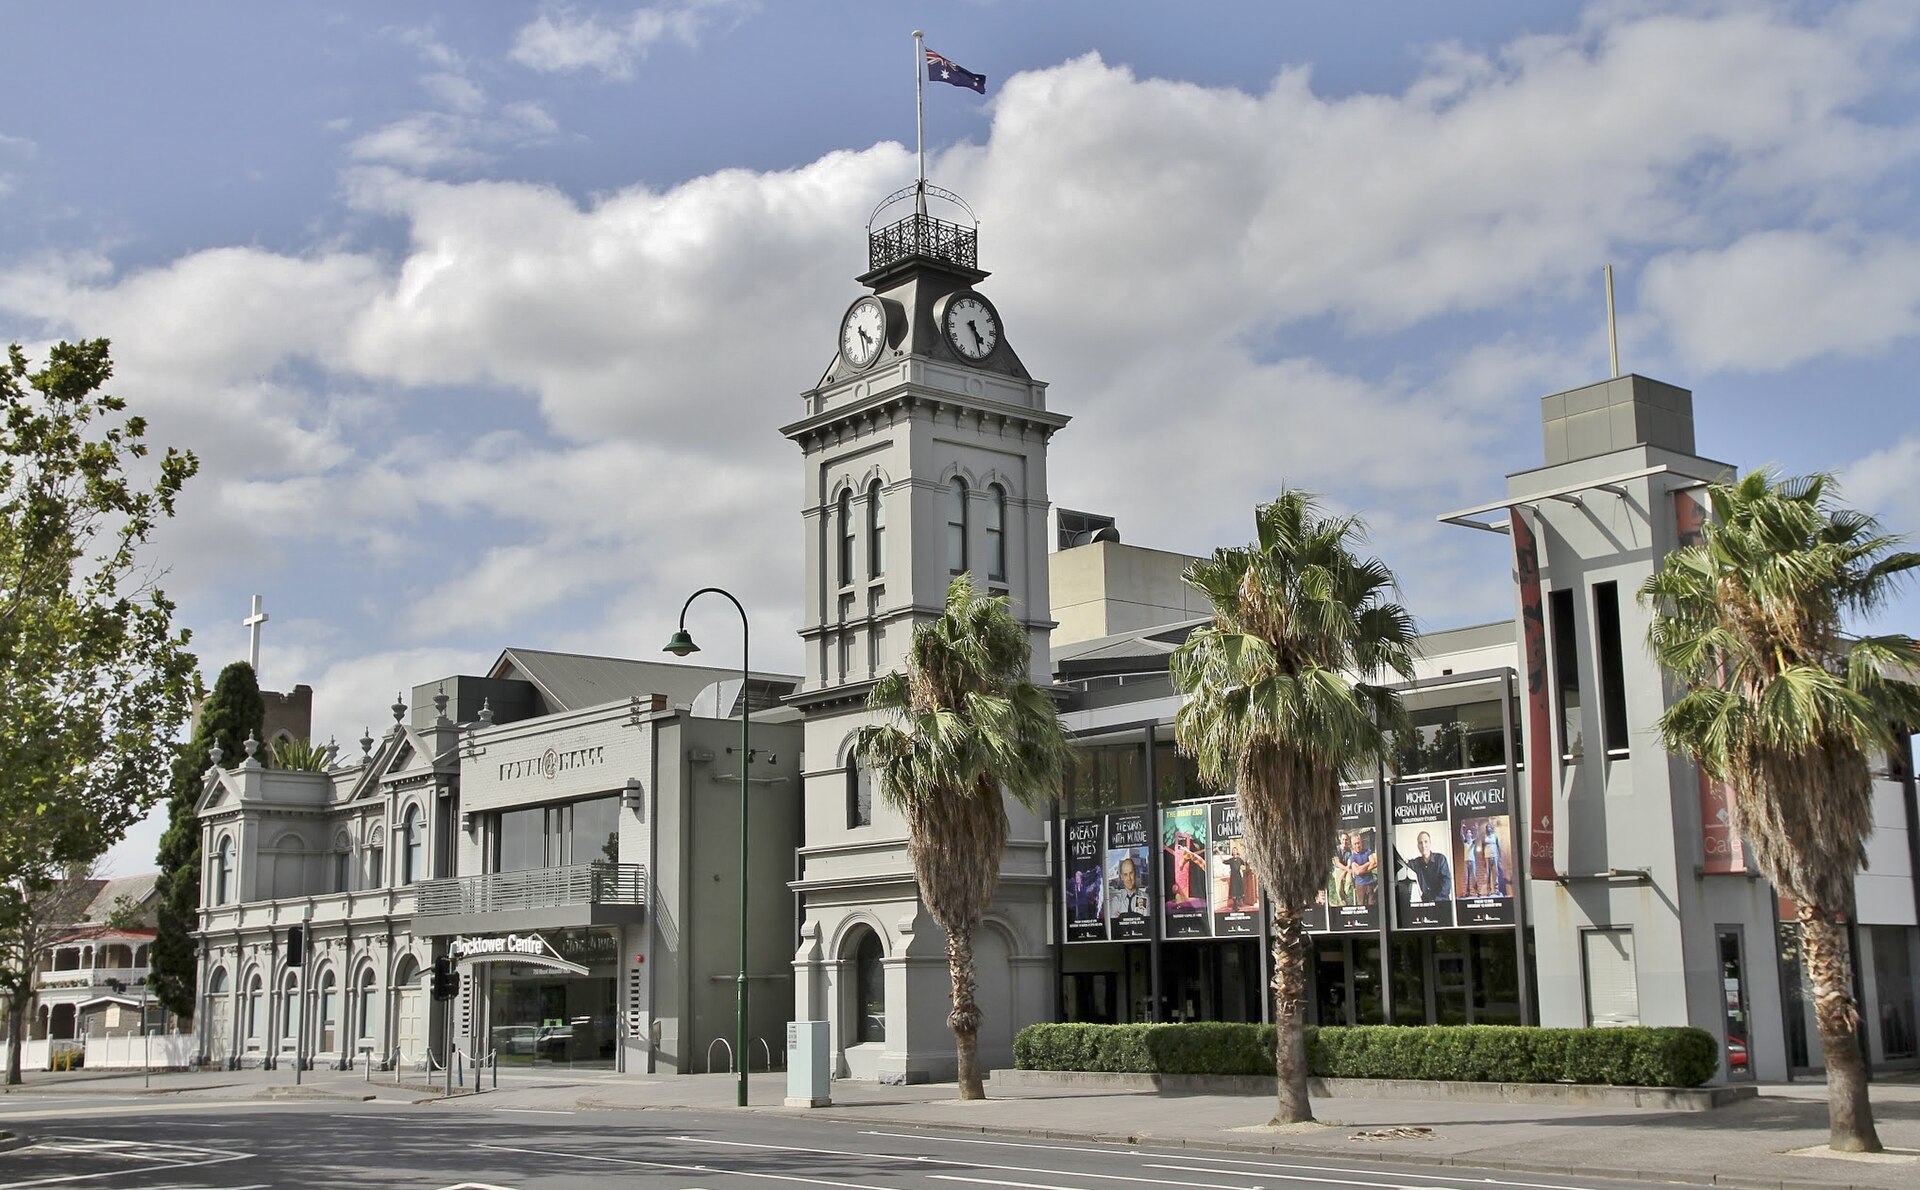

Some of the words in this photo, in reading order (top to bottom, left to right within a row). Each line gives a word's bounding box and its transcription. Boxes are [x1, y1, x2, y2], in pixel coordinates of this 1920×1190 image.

[499, 757, 542, 781] TOWN
[559, 746, 604, 771] HALL
[1406, 791, 1432, 803] MICHAEL
[1166, 811, 1176, 819] THE
[1192, 808, 1203, 816] ZOO
[1353, 802, 1363, 815] OF
[1364, 801, 1374, 813] US
[1394, 804, 1418, 817] KIERAN
[1419, 802, 1444, 816] HARVEY
[1069, 824, 1099, 841] BREAST
[1112, 833, 1125, 844] WITH
[1071, 840, 1097, 856] WISHES
[508, 934, 542, 955] Centre
